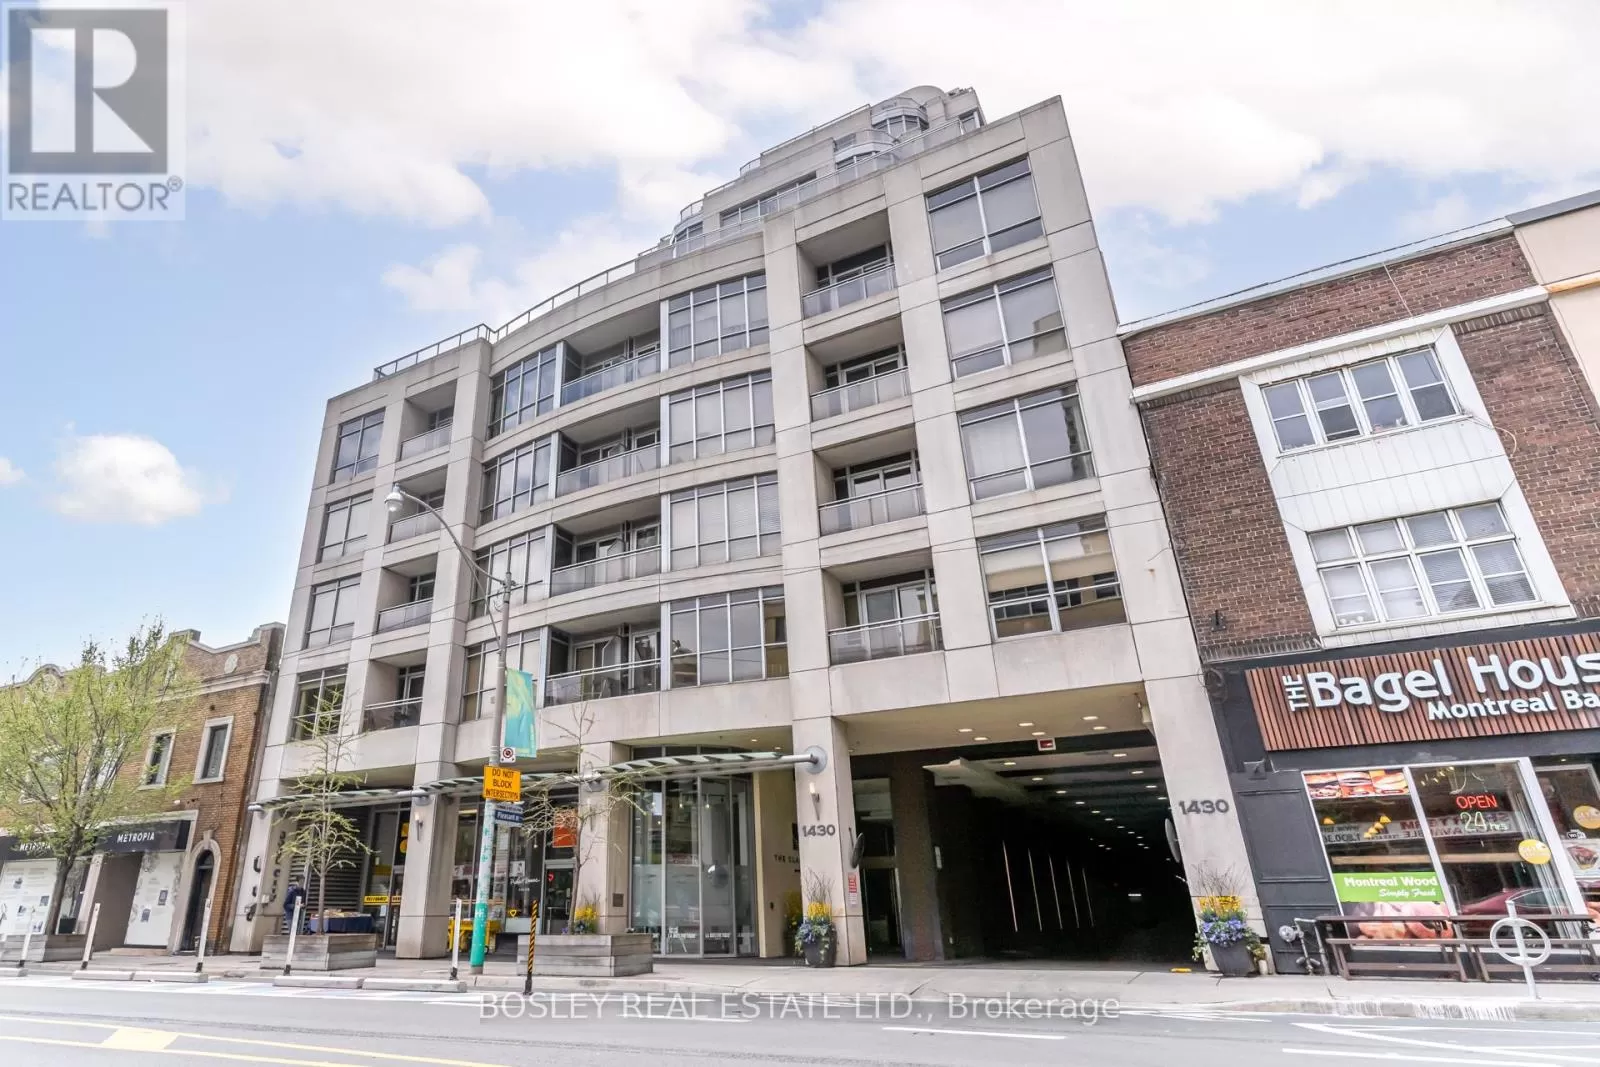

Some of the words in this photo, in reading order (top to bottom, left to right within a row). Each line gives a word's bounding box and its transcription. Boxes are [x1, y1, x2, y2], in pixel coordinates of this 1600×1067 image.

[1307, 658, 1452, 712] Bagel
[1282, 674, 1308, 711] THE
[1427, 693, 1557, 721] Montreal
[492, 769, 501, 777] DO
[493, 779, 513, 788] BLOCK
[486, 788, 518, 800] INTERSECTION
[1178, 799, 1230, 815] 1430
[1455, 794, 1498, 809] OPEN
[1459, 811, 1487, 832] 24
[802, 824, 836, 837] 1430
[117, 832, 155, 843] METROPIA
[773, 854, 786, 864] THE
[1344, 876, 1398, 888] Montreal
[1401, 875, 1439, 887] Wood
